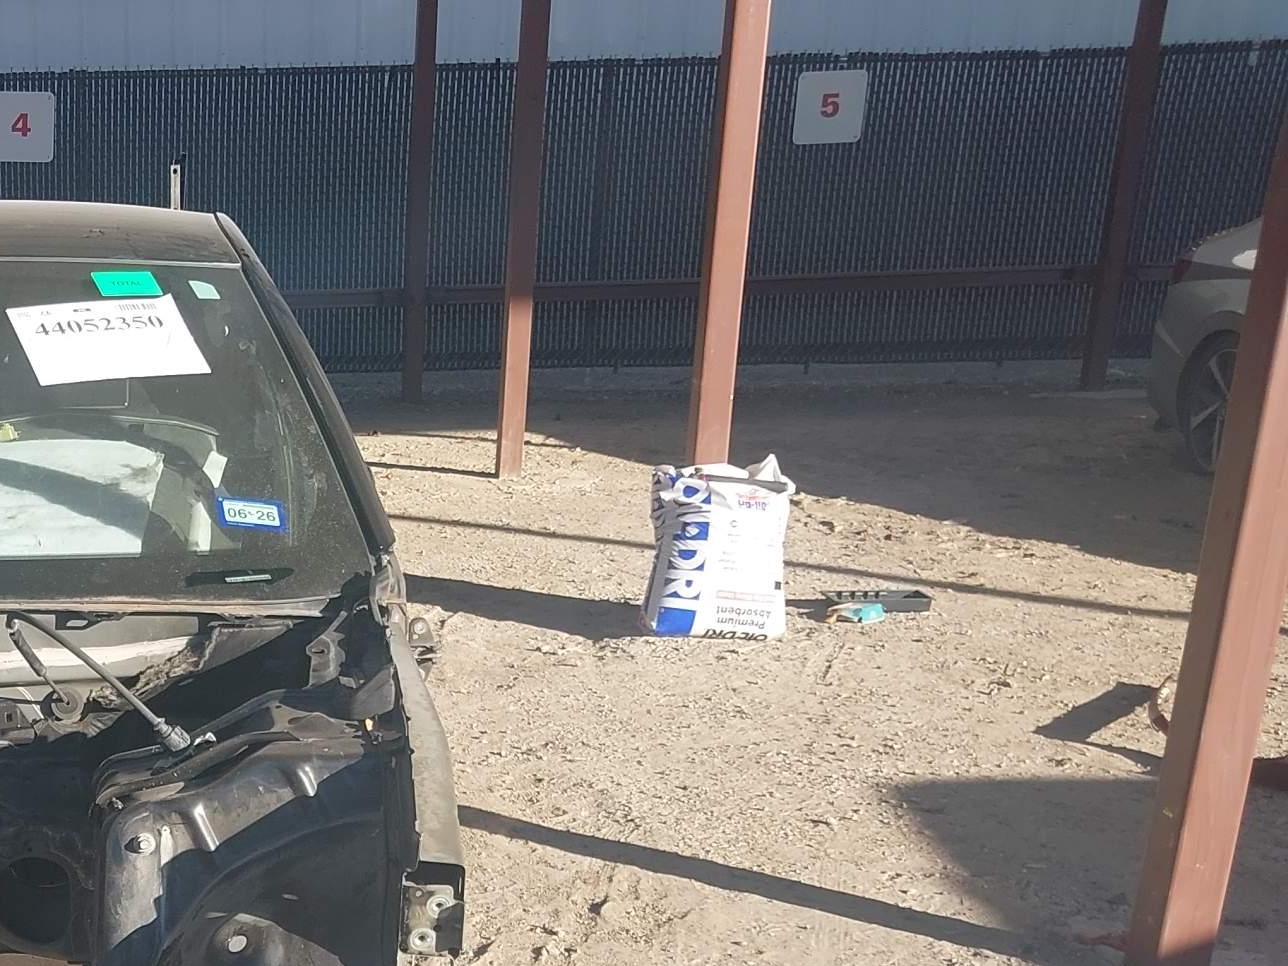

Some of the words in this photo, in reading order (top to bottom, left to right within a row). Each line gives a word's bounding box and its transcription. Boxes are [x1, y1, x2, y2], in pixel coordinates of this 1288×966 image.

[819, 93, 841, 118] 5
[10, 112, 32, 137] 4
[34, 314, 164, 337] 44052350
[716, 606, 772, 620] Absorbent
[716, 617, 766, 630] Premium
